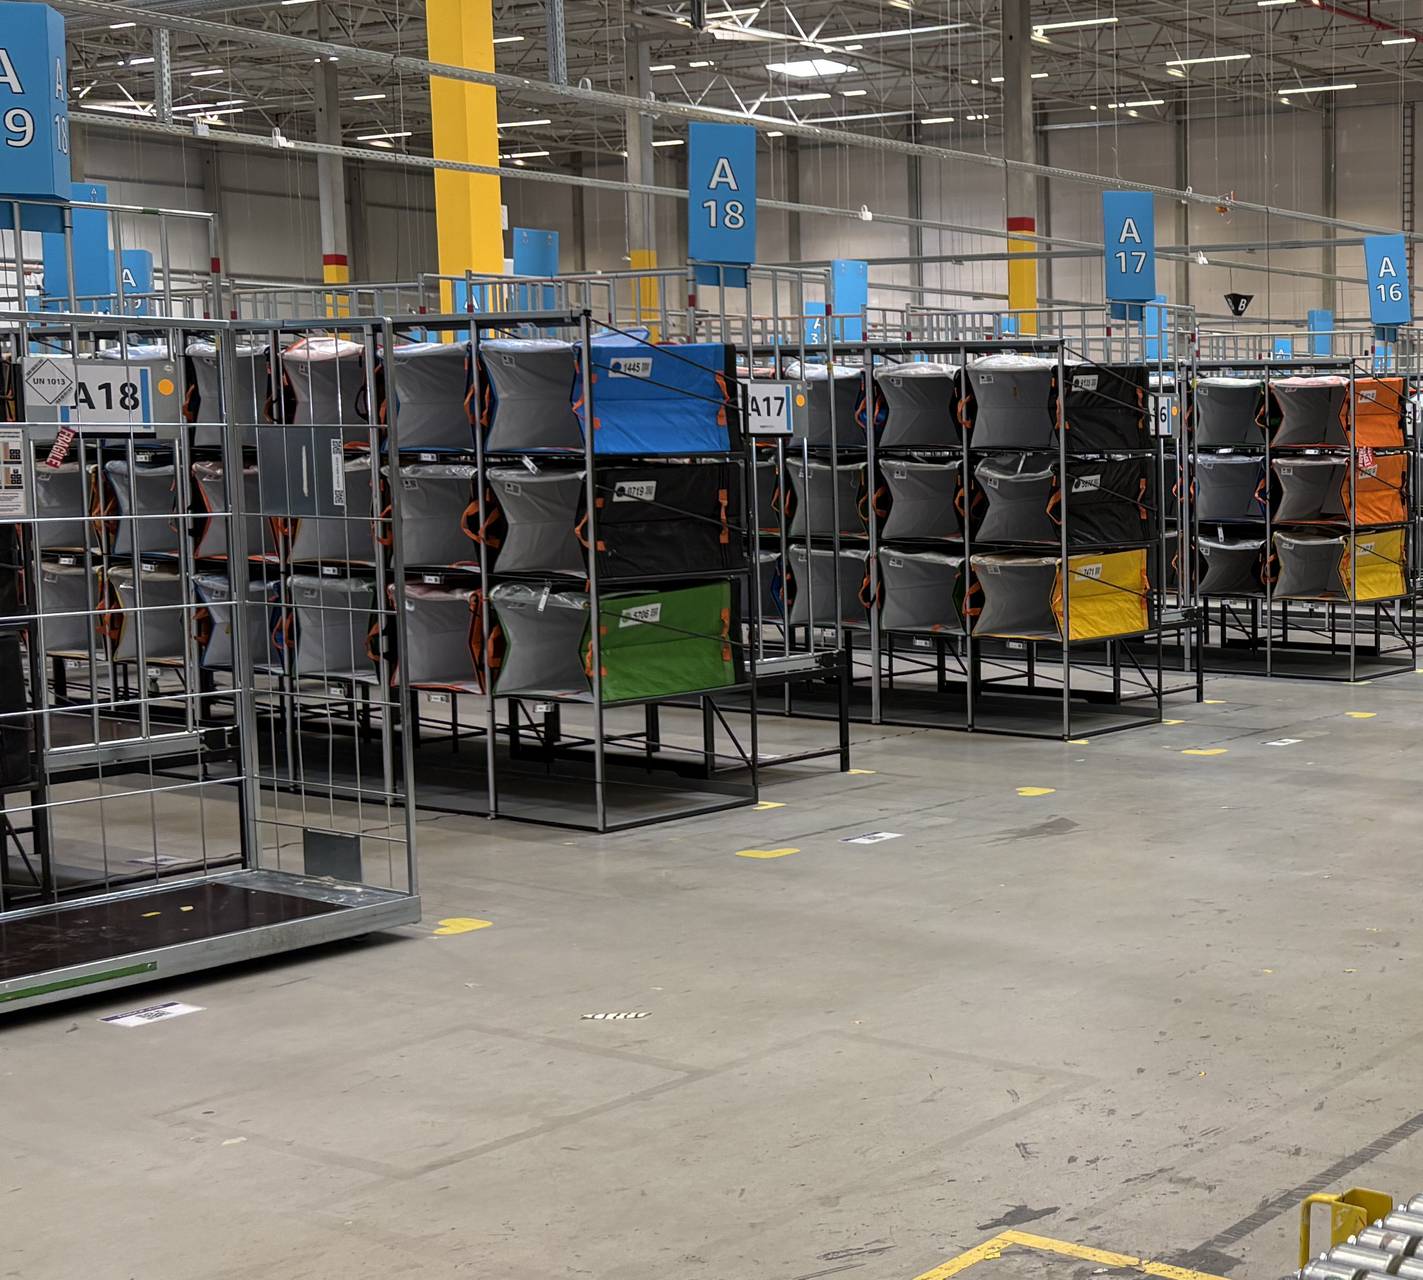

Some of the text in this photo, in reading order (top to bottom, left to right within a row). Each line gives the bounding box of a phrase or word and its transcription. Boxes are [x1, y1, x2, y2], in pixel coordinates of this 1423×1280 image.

[55, 57, 65, 102] A
[54, 113, 69, 155] 18
[707, 157, 740, 191] A
[702, 199, 745, 230] 18
[1119, 217, 1142, 243] A
[1114, 251, 1147, 273] 17
[1378, 256, 1397, 278] A
[1238, 298, 1247, 311] B
[1376, 283, 1402, 302] 16
[47, 378, 66, 386] 1013
[70, 382, 140, 411] A18
[748, 396, 785, 417] A17
[46, 427, 75, 467] FRAGILE
